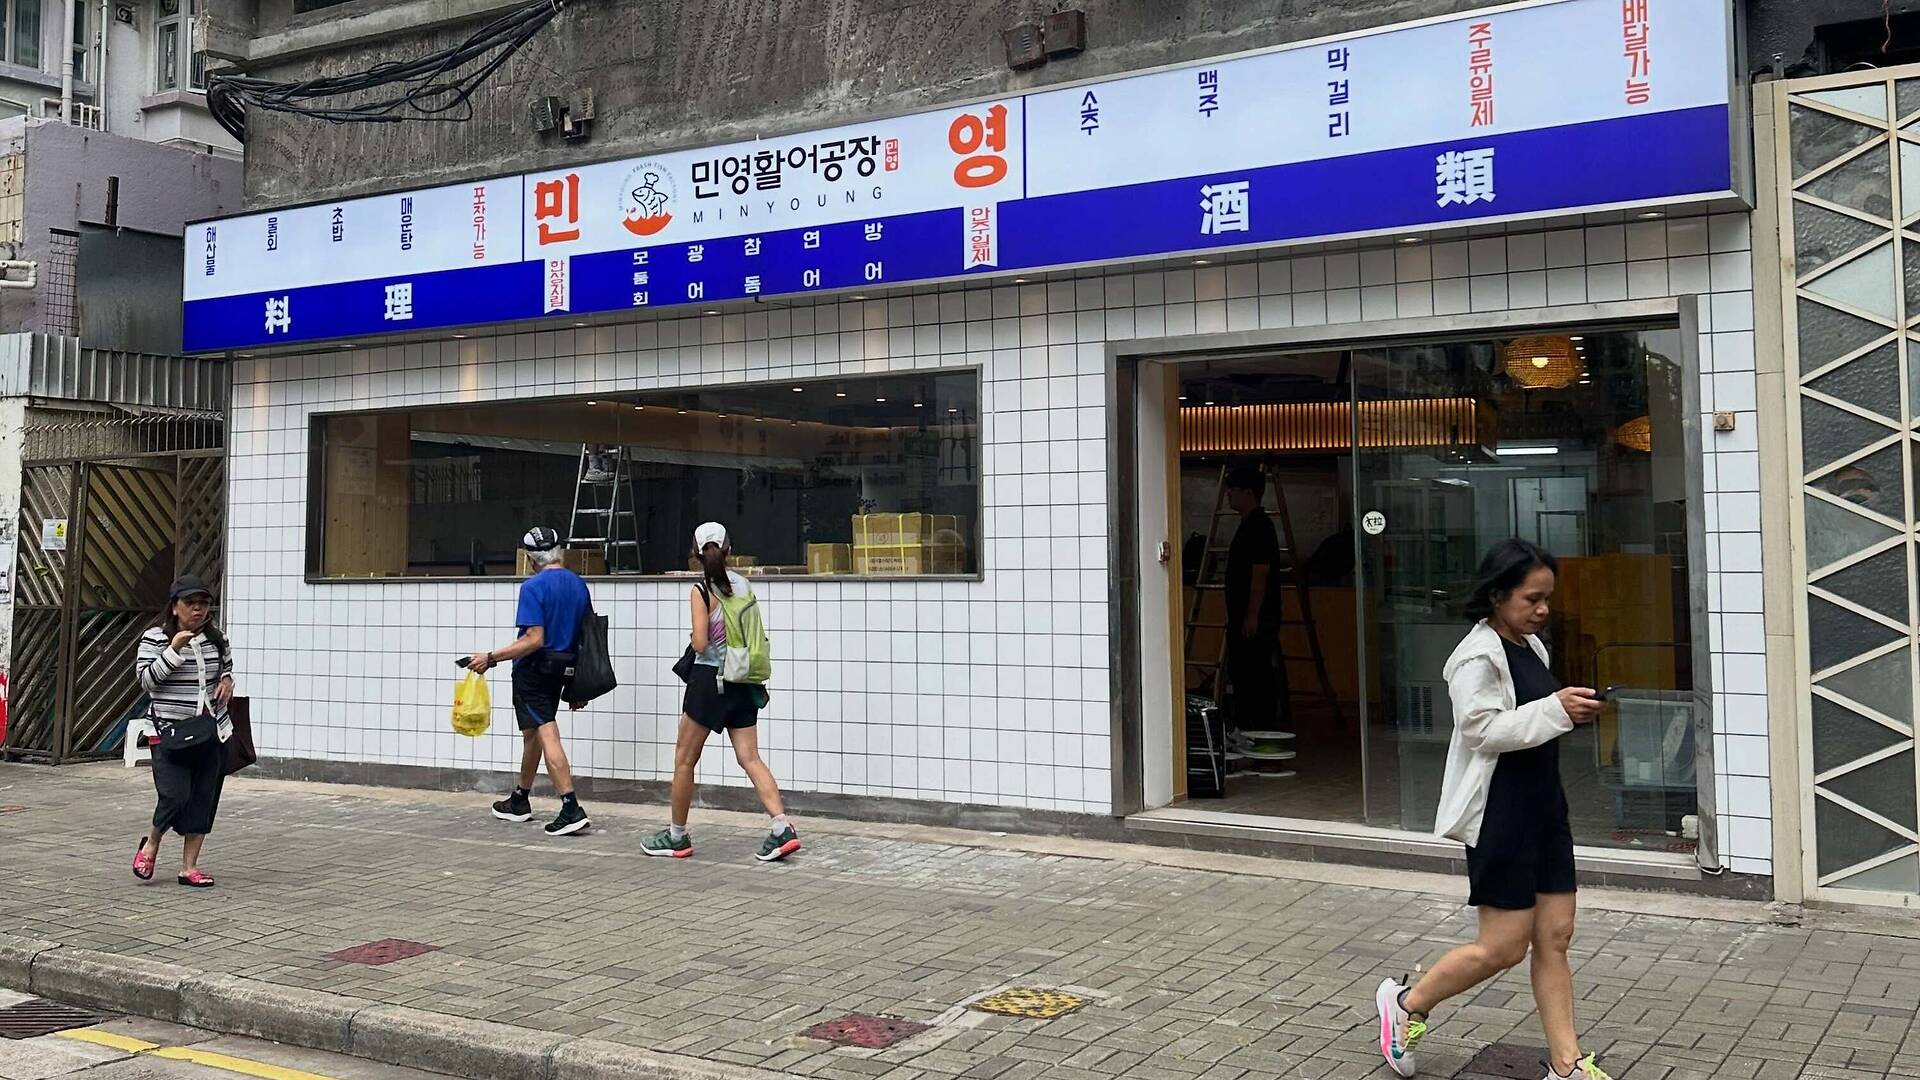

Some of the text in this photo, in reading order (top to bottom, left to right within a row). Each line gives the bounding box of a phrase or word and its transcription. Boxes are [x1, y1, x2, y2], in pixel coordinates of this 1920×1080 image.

[1469, 22, 1494, 127] 주류일제
[1623, 0, 1651, 104] 배달가능
[1080, 91, 1099, 135] 소주
[1198, 69, 1218, 118] 맥주
[1327, 47, 1350, 138] 막걸리
[691, 135, 881, 200] 민영활어공장
[885, 140, 899, 171] 민영
[948, 104, 1008, 188] 영
[534, 173, 580, 245] 민
[1200, 148, 1496, 235] 酒 類
[267, 217, 277, 251] 물회
[333, 207, 343, 242] 초밥
[401, 197, 412, 250] 매운탕
[473, 186, 485, 260] 포장가능
[971, 207, 991, 263] 안주일제
[206, 227, 216, 276] 해산물
[632, 249, 649, 305] 모둠회
[687, 245, 704, 299] 광어
[802, 231, 820, 287] 연어
[864, 223, 884, 280] 방어
[265, 283, 413, 334] 料 理
